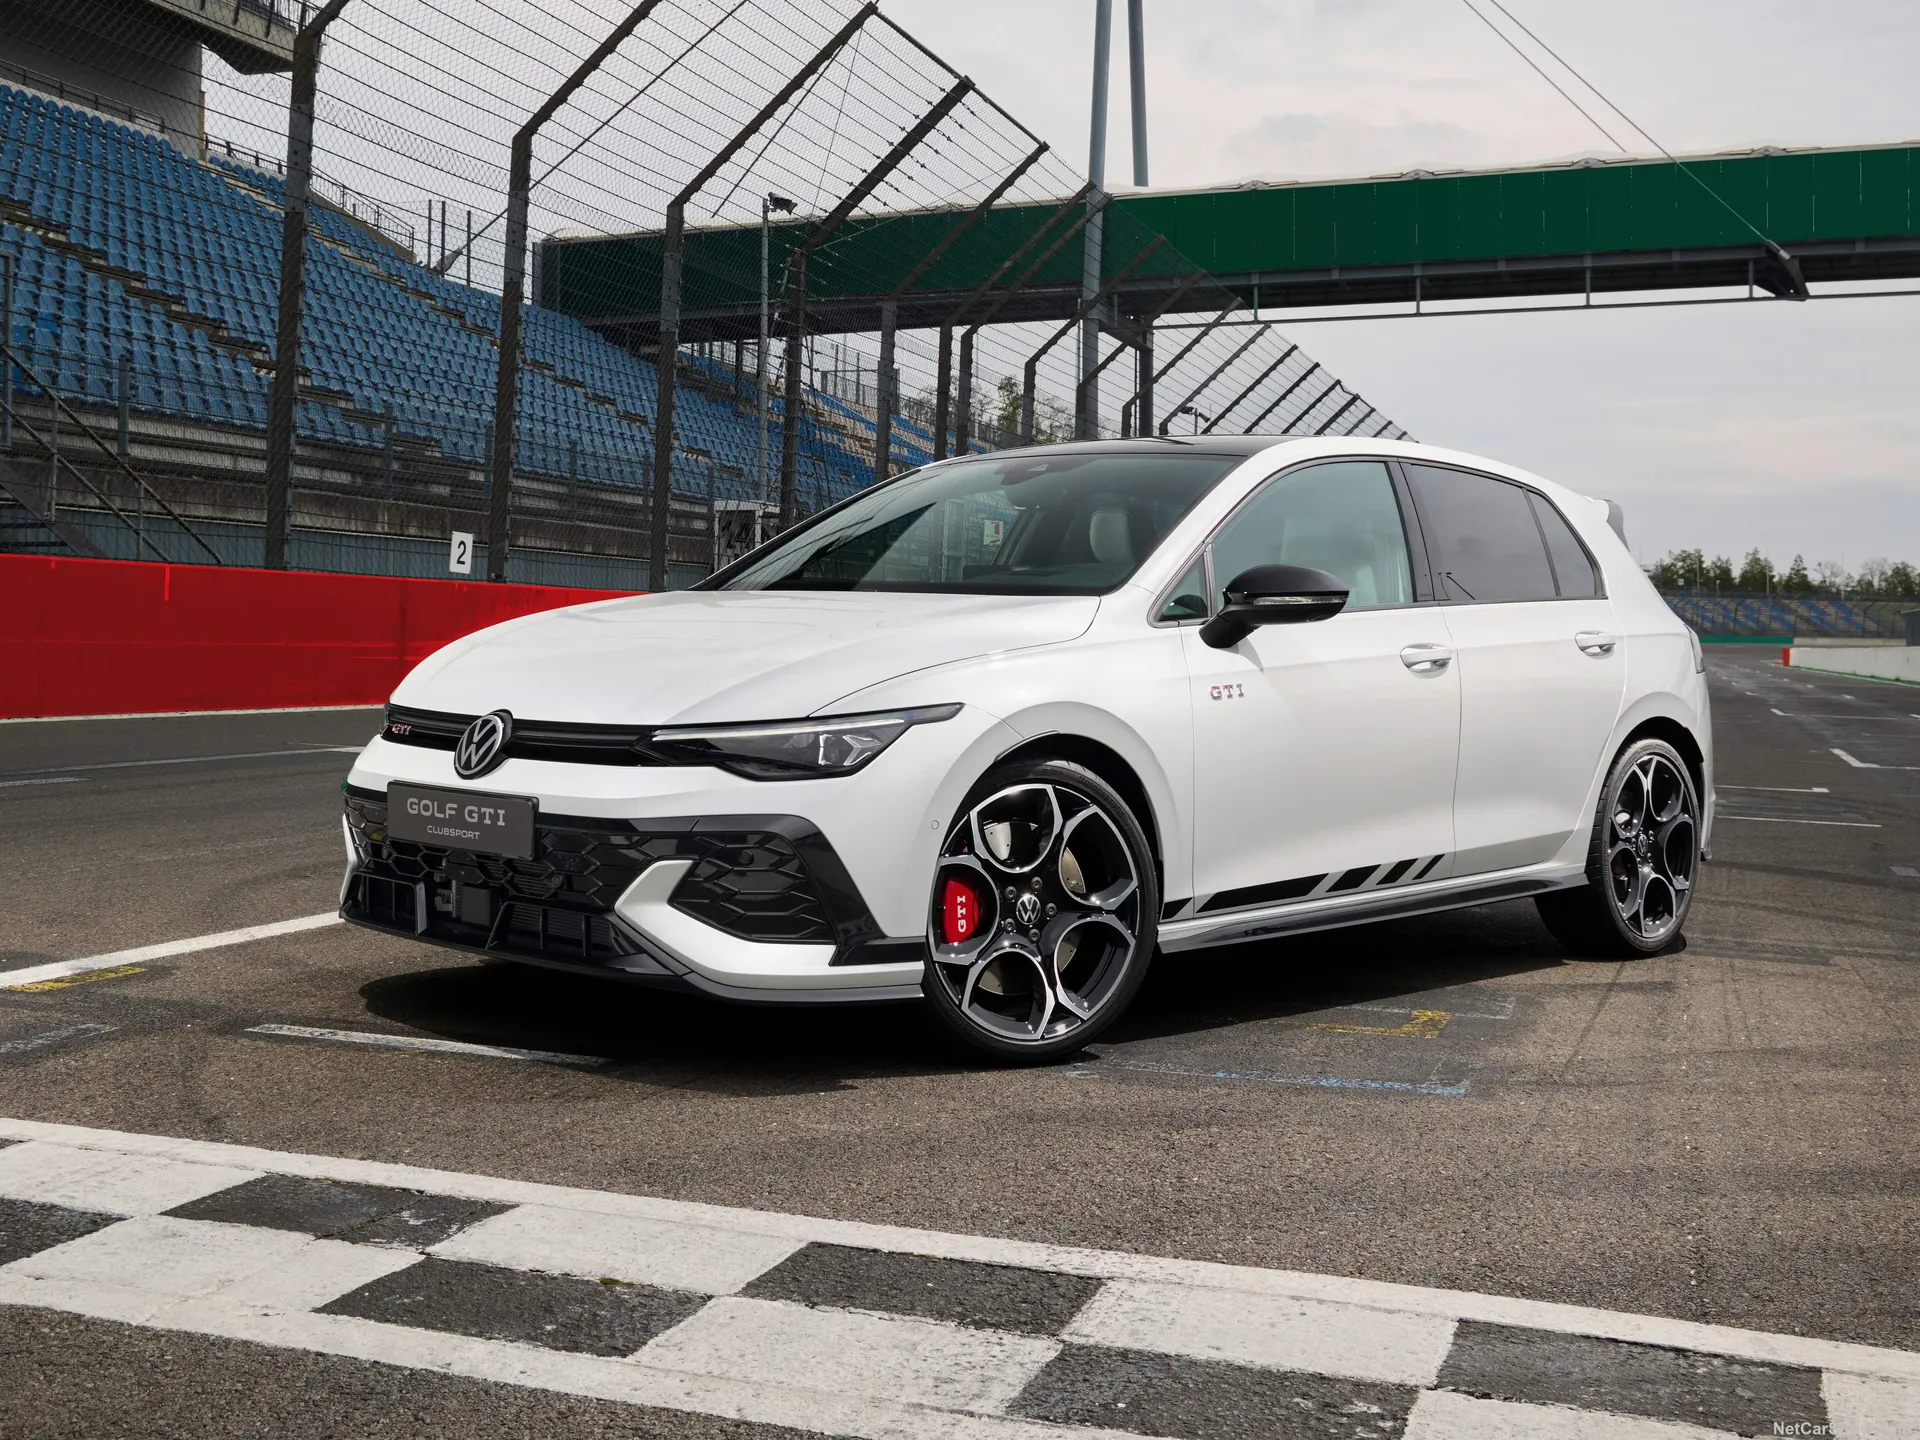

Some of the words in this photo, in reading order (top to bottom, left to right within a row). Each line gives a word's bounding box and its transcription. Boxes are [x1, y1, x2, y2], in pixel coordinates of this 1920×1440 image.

[456, 540, 467, 565] 2
[1210, 683, 1244, 701] GTI
[391, 723, 412, 736] GTI
[406, 797, 458, 819] GOLF
[464, 805, 505, 826] GTI
[426, 825, 480, 840] CLUBSPORT
[956, 895, 967, 933] GTI
